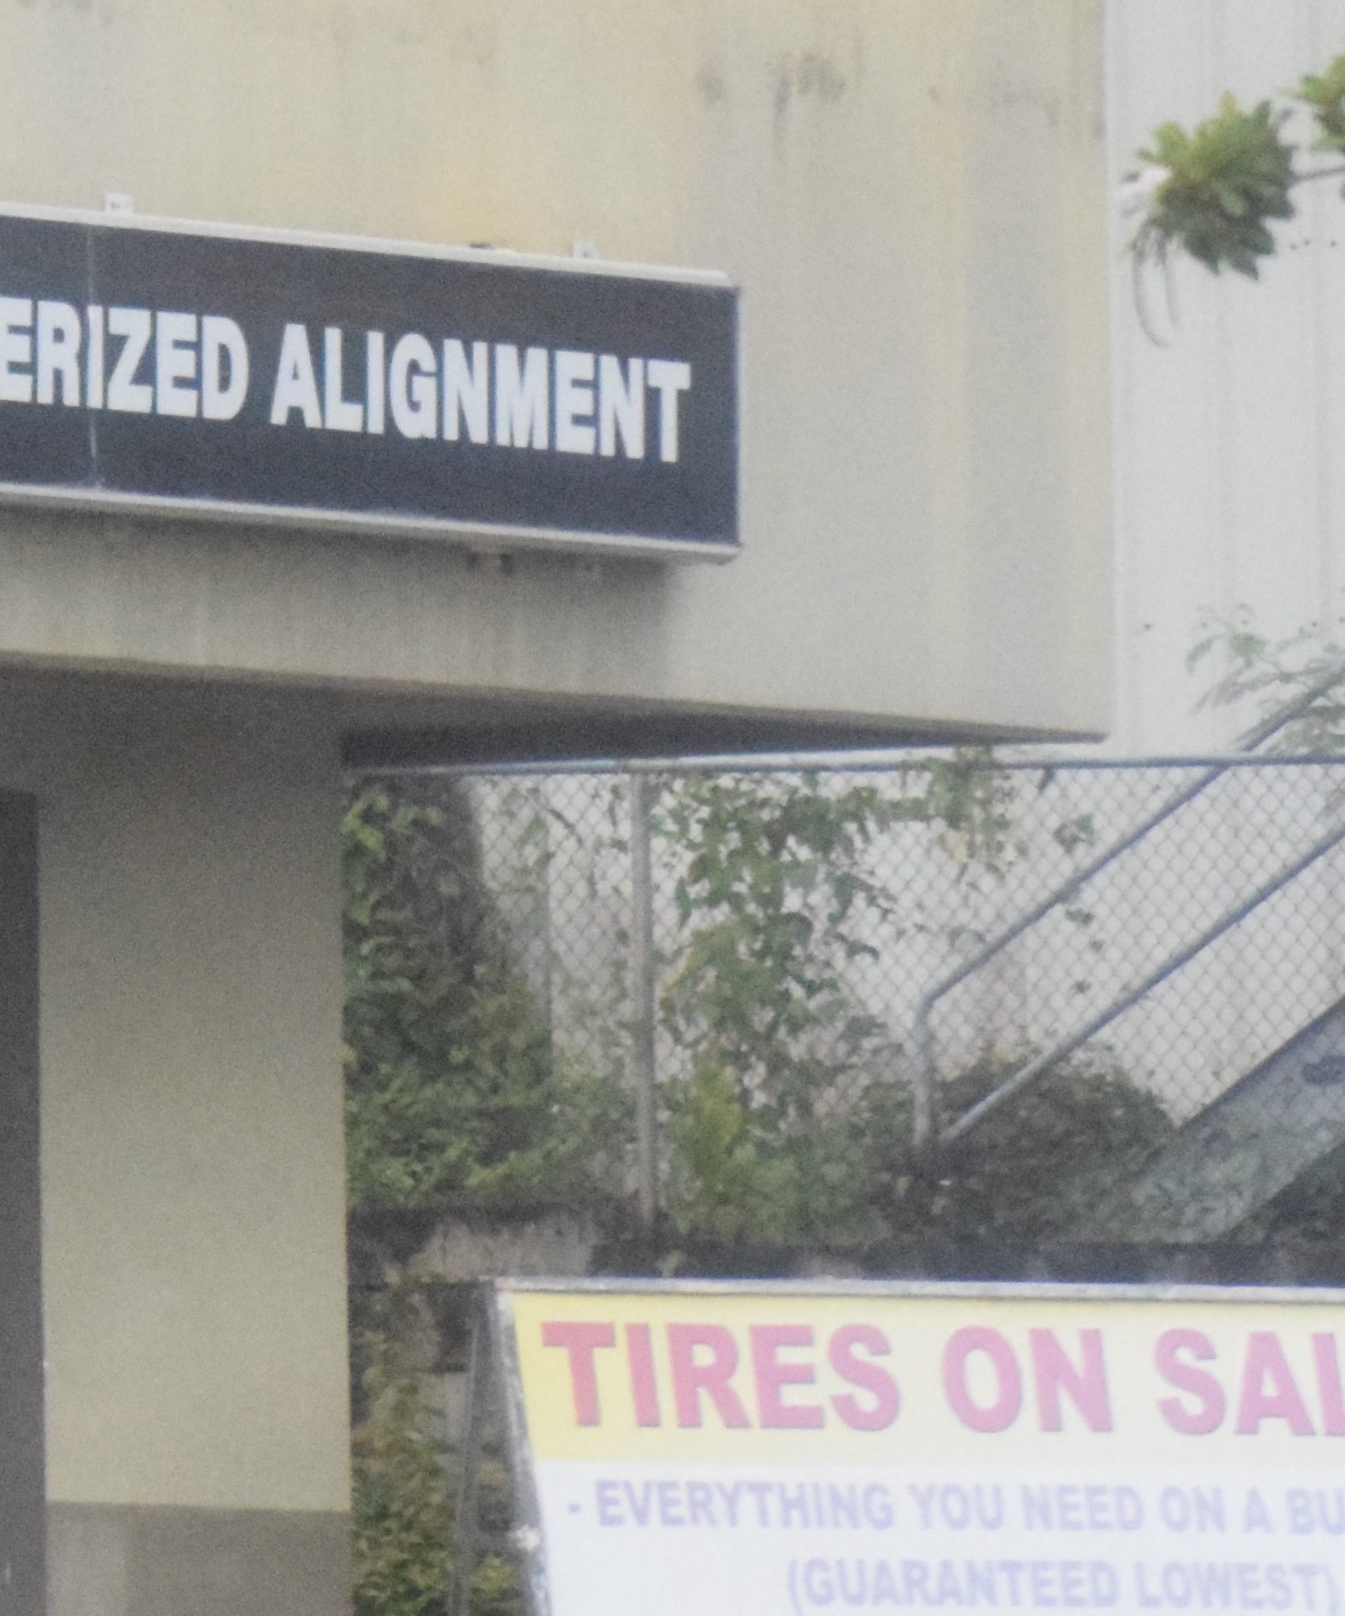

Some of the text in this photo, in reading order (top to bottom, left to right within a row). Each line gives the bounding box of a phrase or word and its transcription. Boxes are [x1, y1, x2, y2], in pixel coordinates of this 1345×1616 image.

[270, 323, 691, 462] ALIGNMENT
[541, 1321, 901, 1432] TIRES
[941, 1325, 1113, 1434] ON
[595, 1479, 896, 1531] EVERYTHING
[910, 1482, 1005, 1531] YOU
[1021, 1483, 1146, 1532] NEED
[1159, 1484, 1229, 1535] ON
[1243, 1486, 1276, 1535] A
[786, 1556, 1120, 1616] (GUARANTEED
